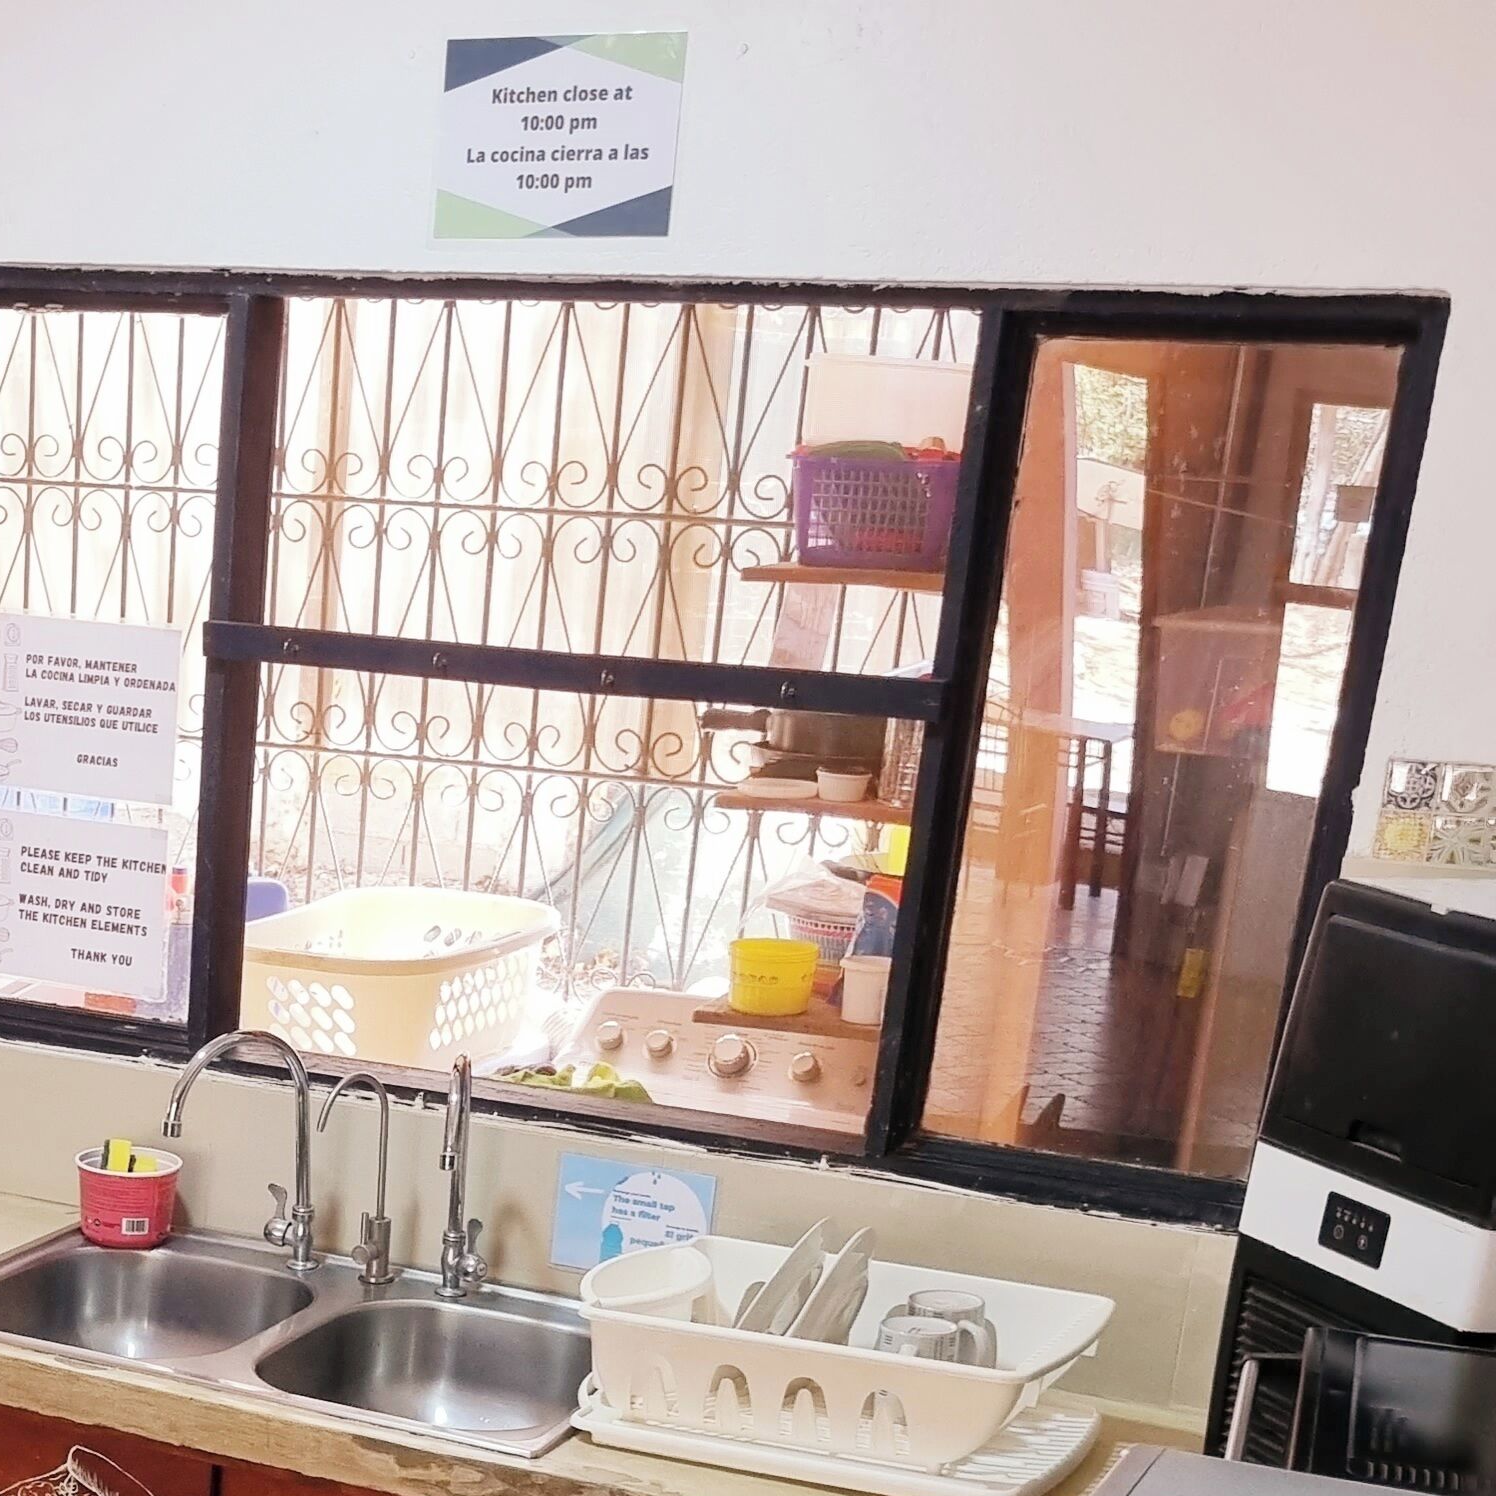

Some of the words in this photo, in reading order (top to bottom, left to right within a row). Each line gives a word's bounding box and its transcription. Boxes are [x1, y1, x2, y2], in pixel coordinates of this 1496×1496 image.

[492, 86, 558, 104] Kitchen
[563, 85, 609, 102] close
[613, 85, 633, 101] at
[521, 115, 564, 131] 10:00
[569, 114, 598, 134] pm
[466, 148, 486, 164] La
[490, 146, 546, 162] cocina
[550, 144, 603, 161] cierra
[608, 147, 619, 160] a
[623, 144, 650, 160] las
[516, 174, 560, 190] 10:00
[564, 174, 592, 193] pm
[26, 654, 44, 665] POR
[47, 656, 81, 669] FAVOR,
[85, 660, 137, 674] MANTENER
[26, 668, 37, 679] LA
[41, 669, 75, 683] COCINA
[78, 674, 110, 686] LIMPIA
[114, 677, 120, 687] Y
[123, 677, 176, 692] ORDENADA
[25, 696, 58, 710] LAVAR,
[62, 700, 93, 713] SECAR
[97, 703, 102, 714] Y
[107, 704, 152, 719] GUARDAR
[24, 711, 41, 722] LOS
[44, 713, 96, 728] UTENSILIOS
[99, 719, 118, 730] QUE
[122, 721, 158, 734] UTILICE
[77, 754, 119, 768] GRACIAS
[21, 846, 60, 861] PLEASE
[64, 851, 92, 865] KEEP
[96, 855, 117, 869] THE
[122, 858, 167, 874] KITCHEN
[20, 862, 54, 877] CLEAN
[58, 868, 80, 880] AND
[84, 870, 108, 883] TIDY
[19, 893, 51, 909] WASH,
[55, 898, 76, 911] DRY
[80, 902, 102, 915] AND
[106, 905, 141, 920] STORE
[18, 909, 39, 921] THE
[42, 913, 87, 929] KITCHEN
[91, 920, 147, 937] ELEMENTS
[71, 948, 107, 963] THANK
[111, 953, 133, 967] YOU
[613, 1194, 630, 1204] The
[633, 1199, 657, 1208] small
[660, 1203, 675, 1212] tap
[611, 1206, 627, 1216] has
[638, 1210, 661, 1221] filter
